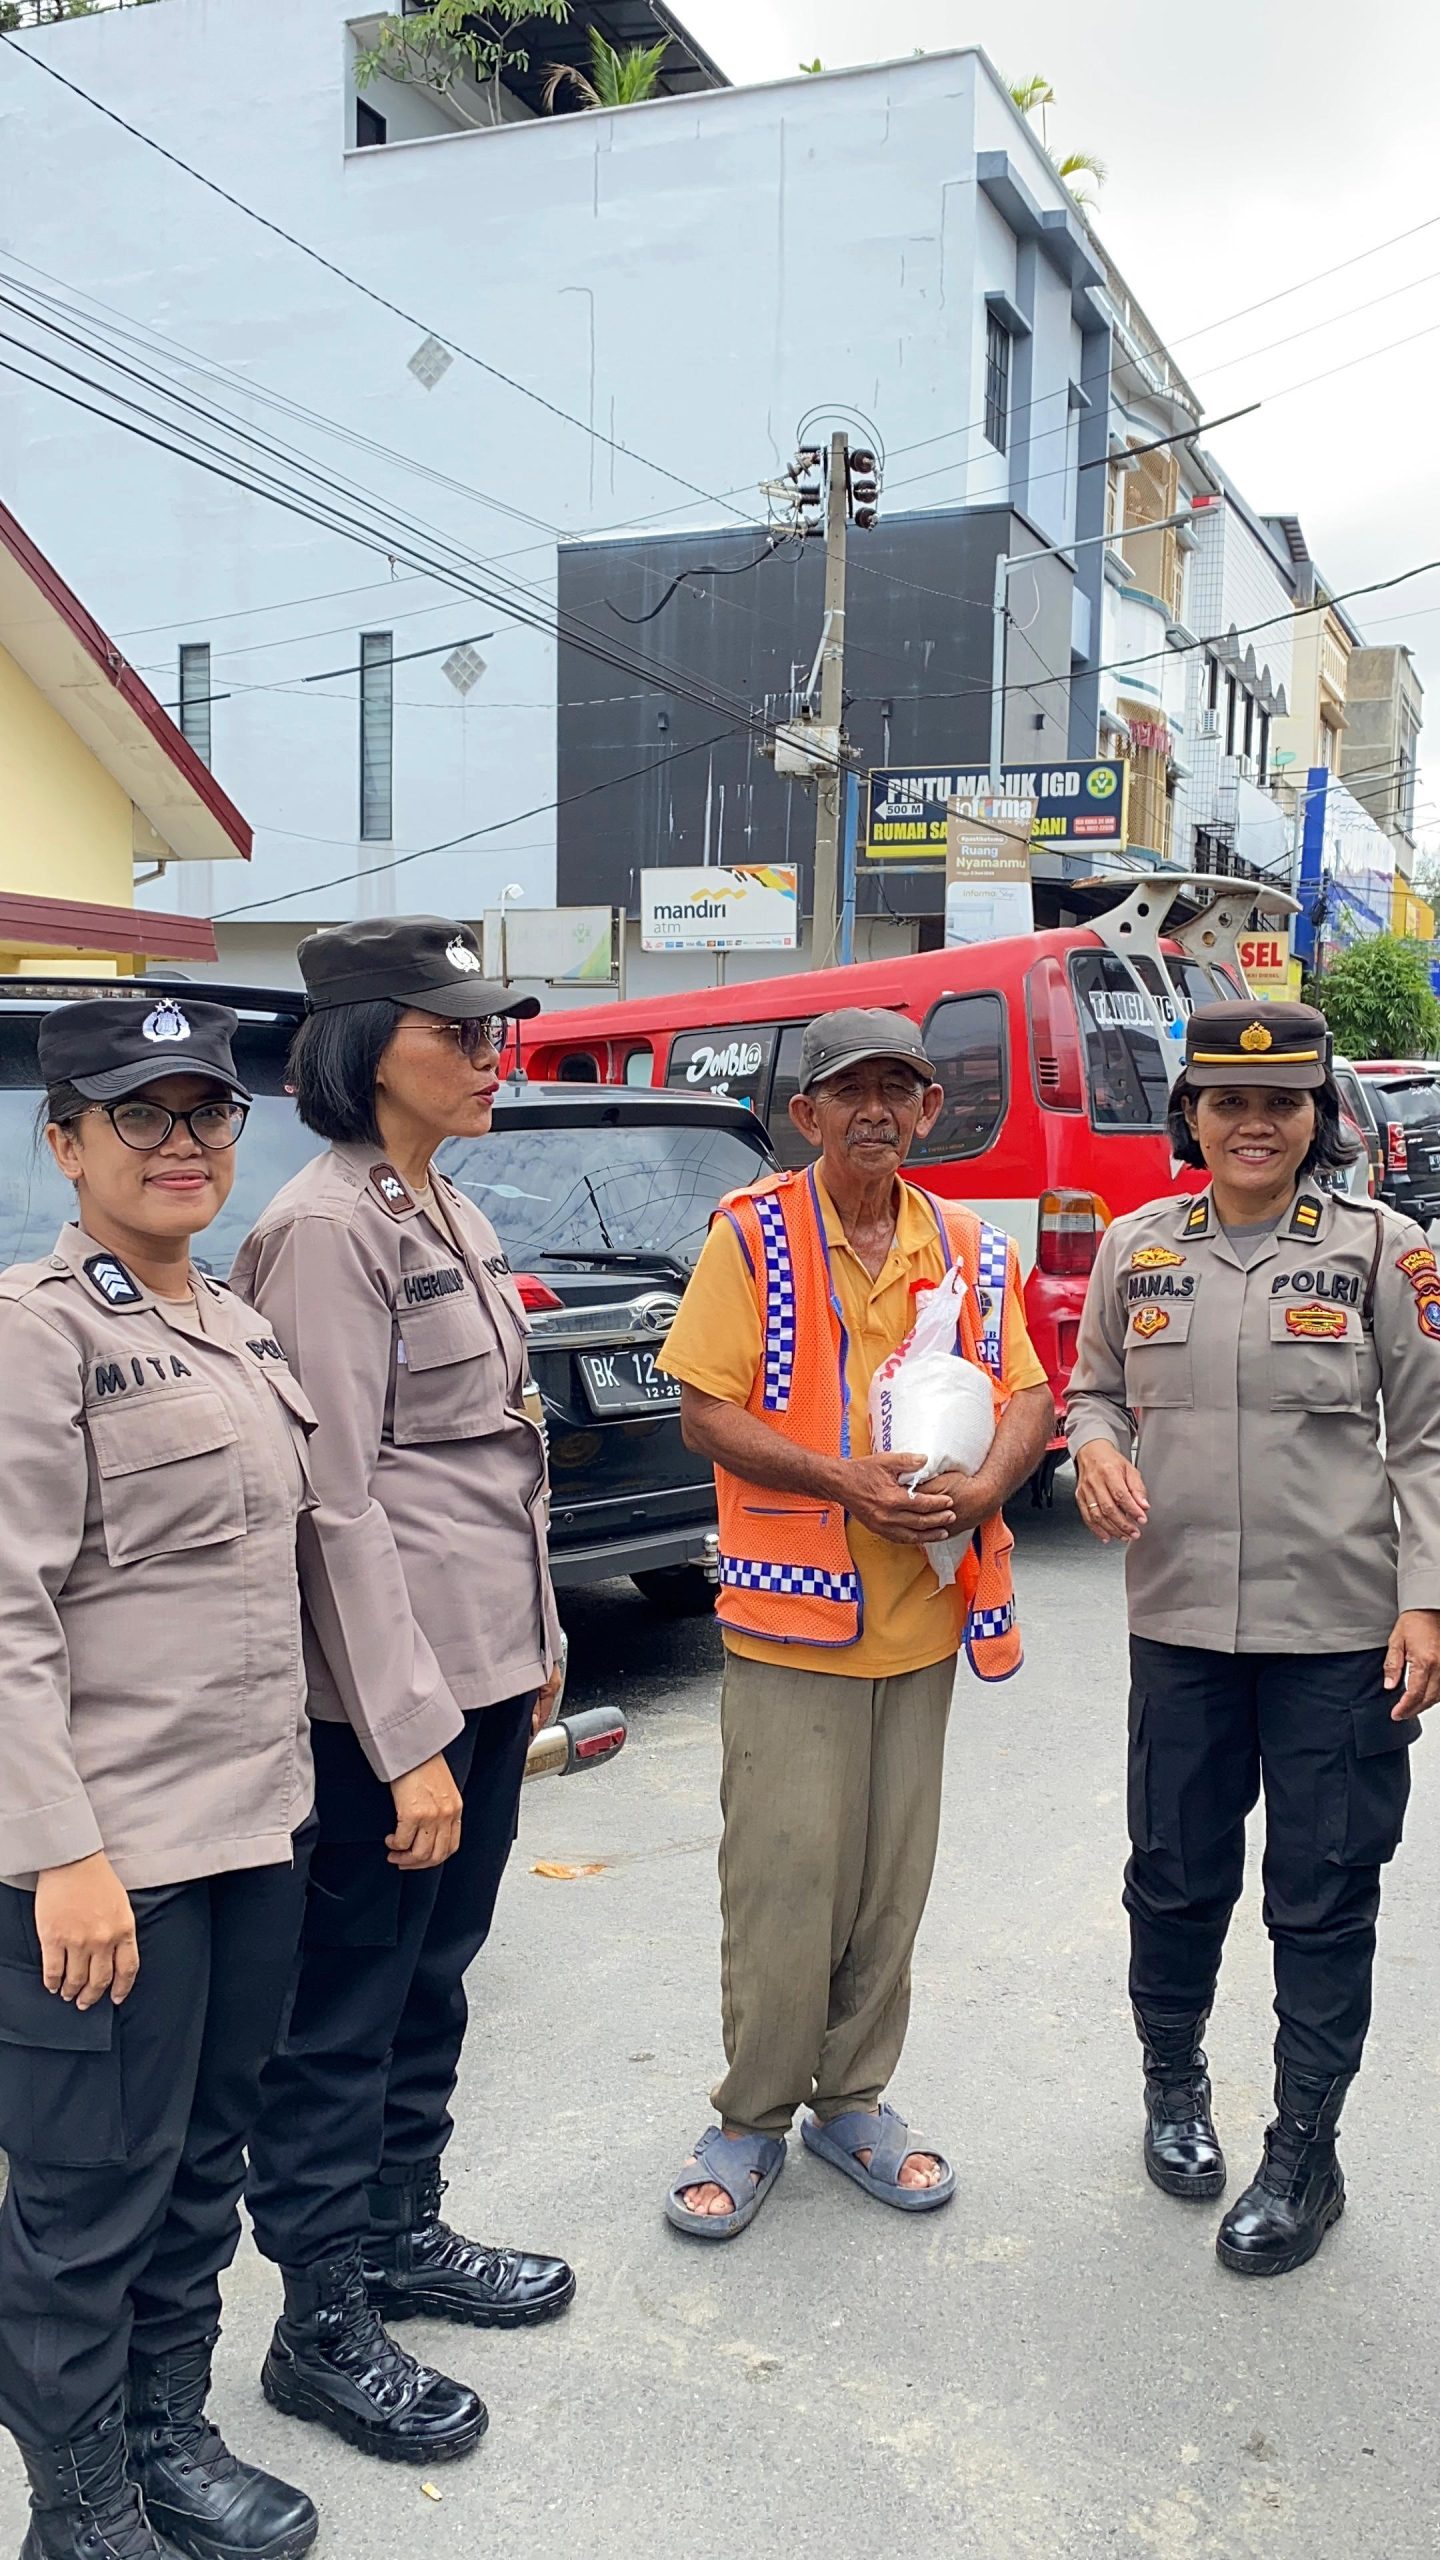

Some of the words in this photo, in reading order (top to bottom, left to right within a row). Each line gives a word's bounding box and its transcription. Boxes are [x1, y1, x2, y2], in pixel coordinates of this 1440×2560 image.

[888, 776, 952, 803] PINTU
[1041, 771, 1080, 798] IGD
[887, 805, 908, 815] 500
[911, 804, 921, 814] M
[956, 796, 1032, 818] informa
[874, 822, 928, 841] RUMAH
[961, 845, 998, 858] Ruang
[956, 857, 1026, 870] Nyamanmu
[654, 900, 726, 919] mandiri
[654, 922, 681, 934] atm
[1237, 942, 1283, 968] SEL
[1271, 1270, 1359, 1302] POLRI
[95, 1355, 192, 1396] MITA
[590, 1356, 621, 1387] BK
[881, 1390, 892, 1416] CAP
